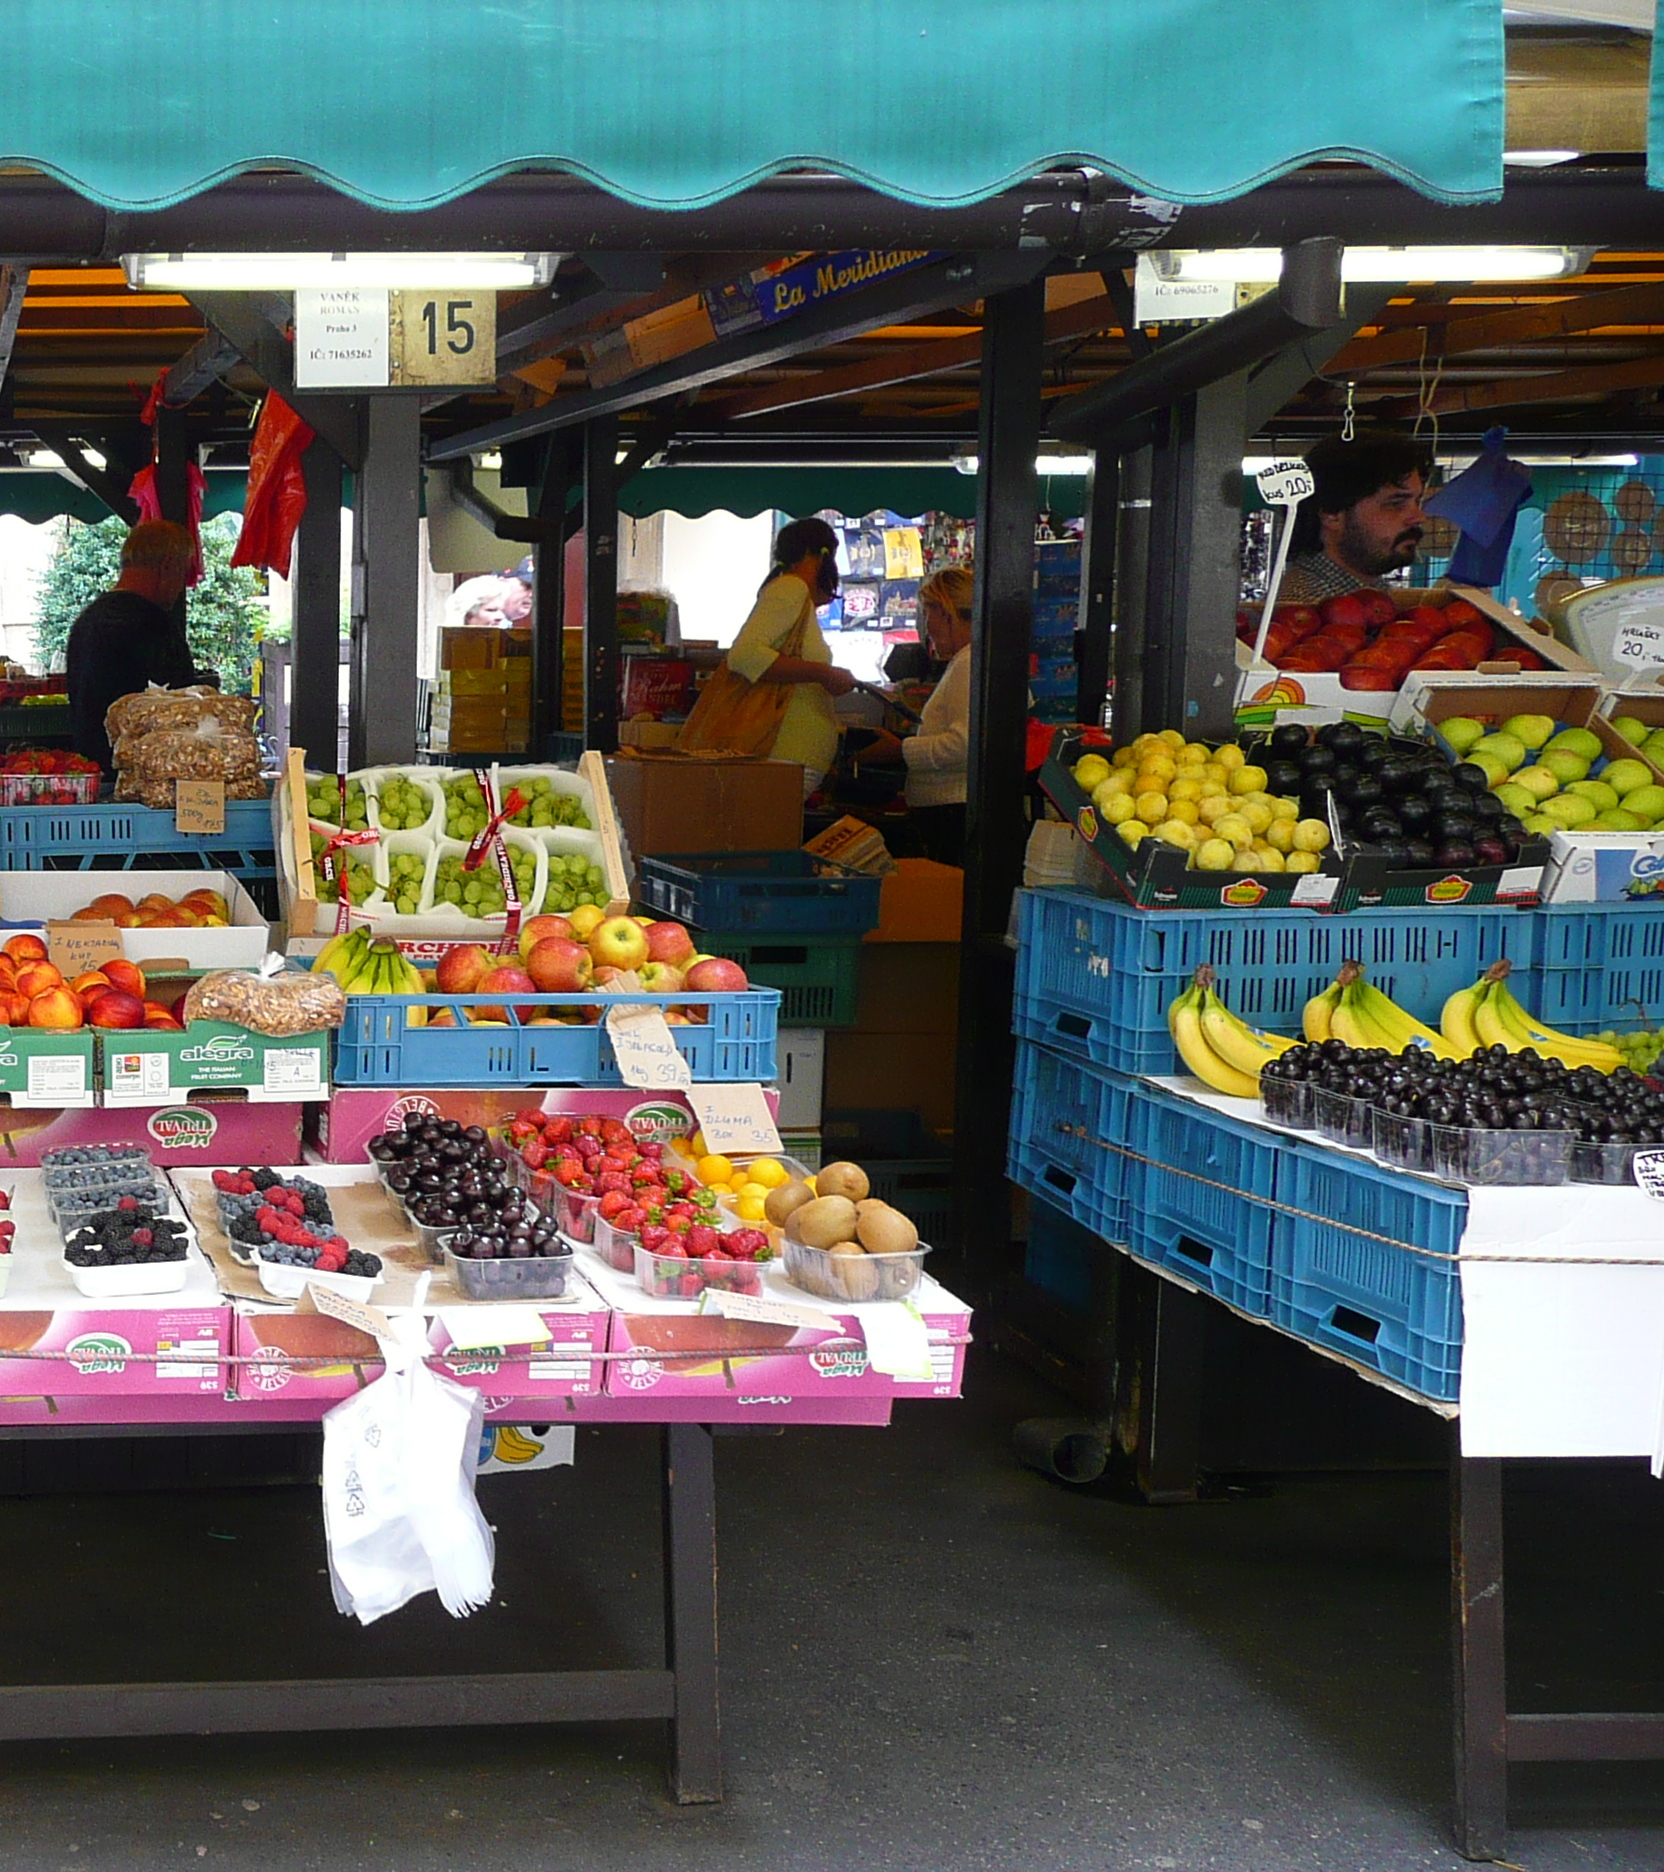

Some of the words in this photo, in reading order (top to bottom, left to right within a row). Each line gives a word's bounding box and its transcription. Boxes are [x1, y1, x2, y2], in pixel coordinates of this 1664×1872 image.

[773, 283, 806, 313] La
[422, 301, 475, 355] 15
[180, 1046, 253, 1062] alegra
[156, 1119, 208, 1133] TRUVAL
